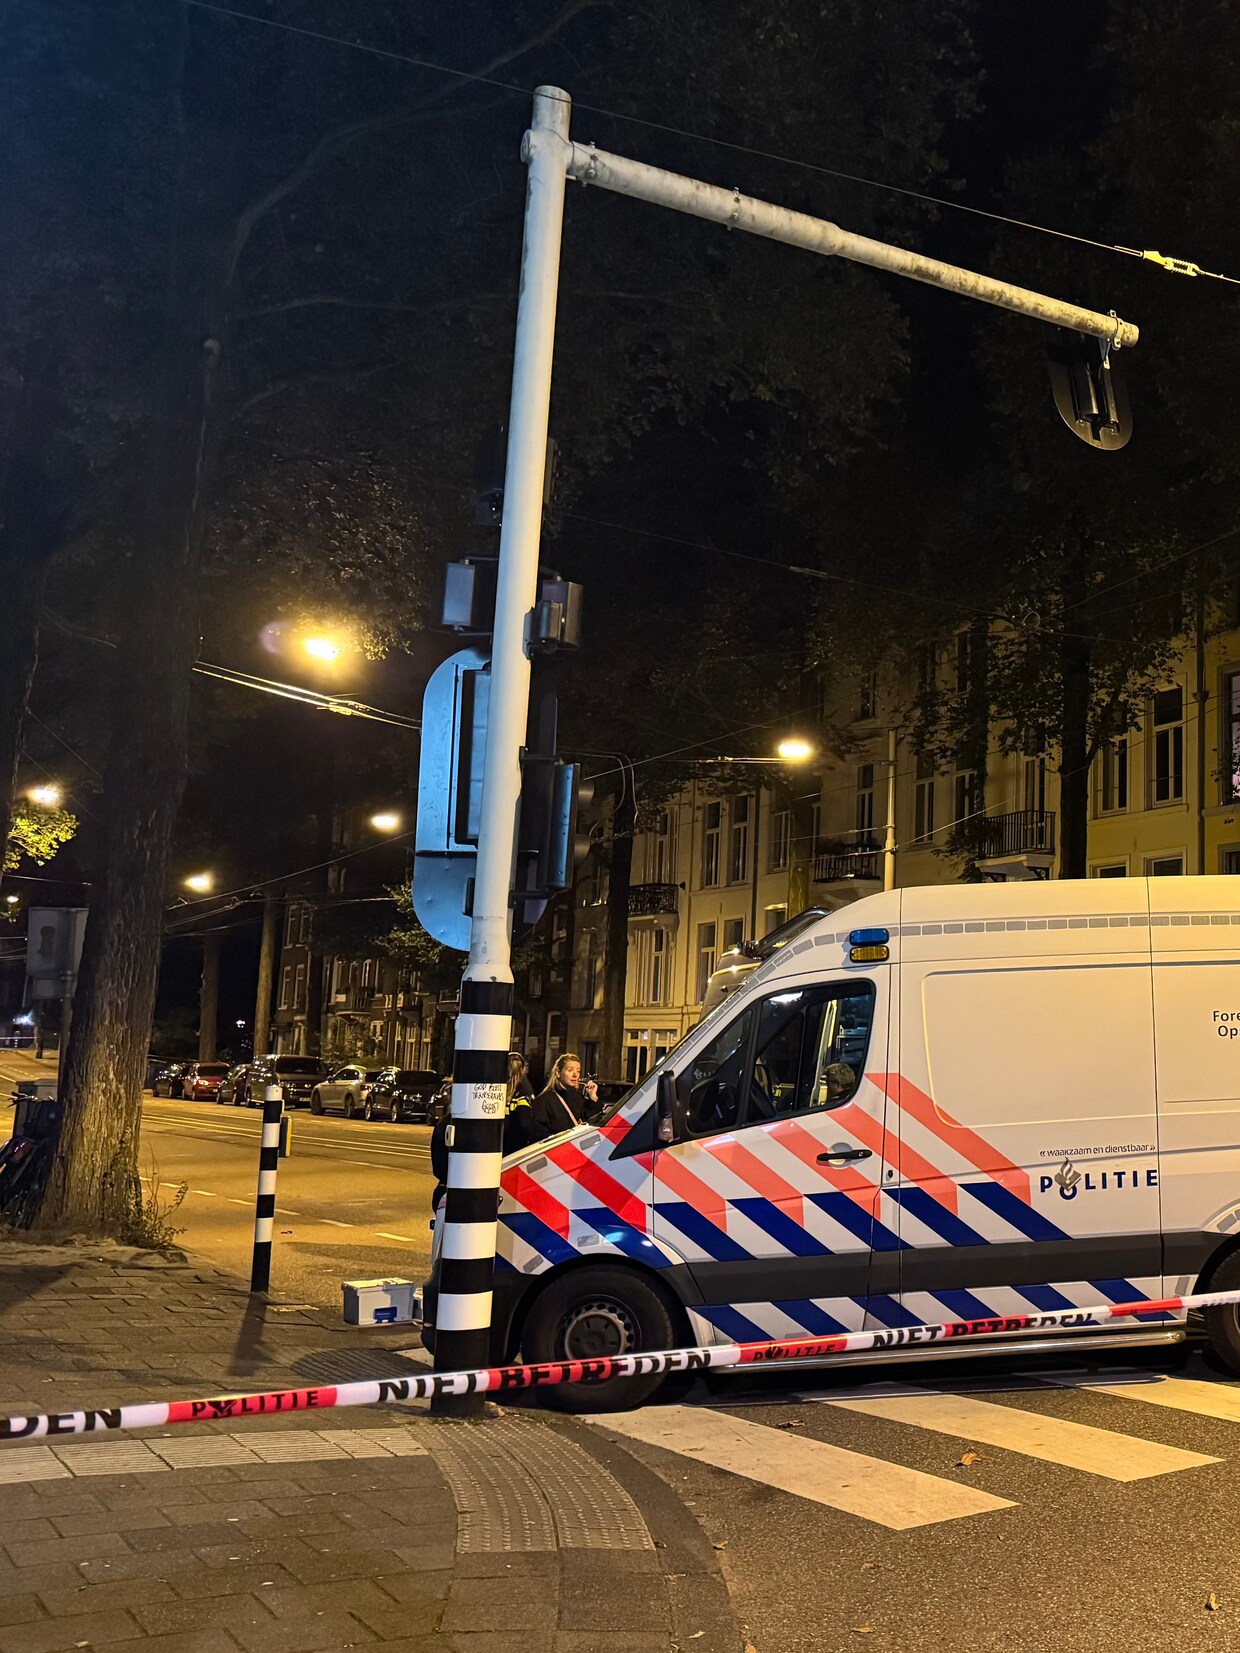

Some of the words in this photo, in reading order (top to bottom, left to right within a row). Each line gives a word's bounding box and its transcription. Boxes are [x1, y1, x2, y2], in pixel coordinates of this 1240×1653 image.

[1093, 1146, 1104, 1154] en
[1105, 1144, 1149, 1153] dienstbaar
[1040, 1169, 1158, 1200] POLITIE
[377, 1371, 478, 1402] NIET
[500, 1348, 712, 1388] BETREDEN
[191, 1390, 320, 1419] POLITIE
